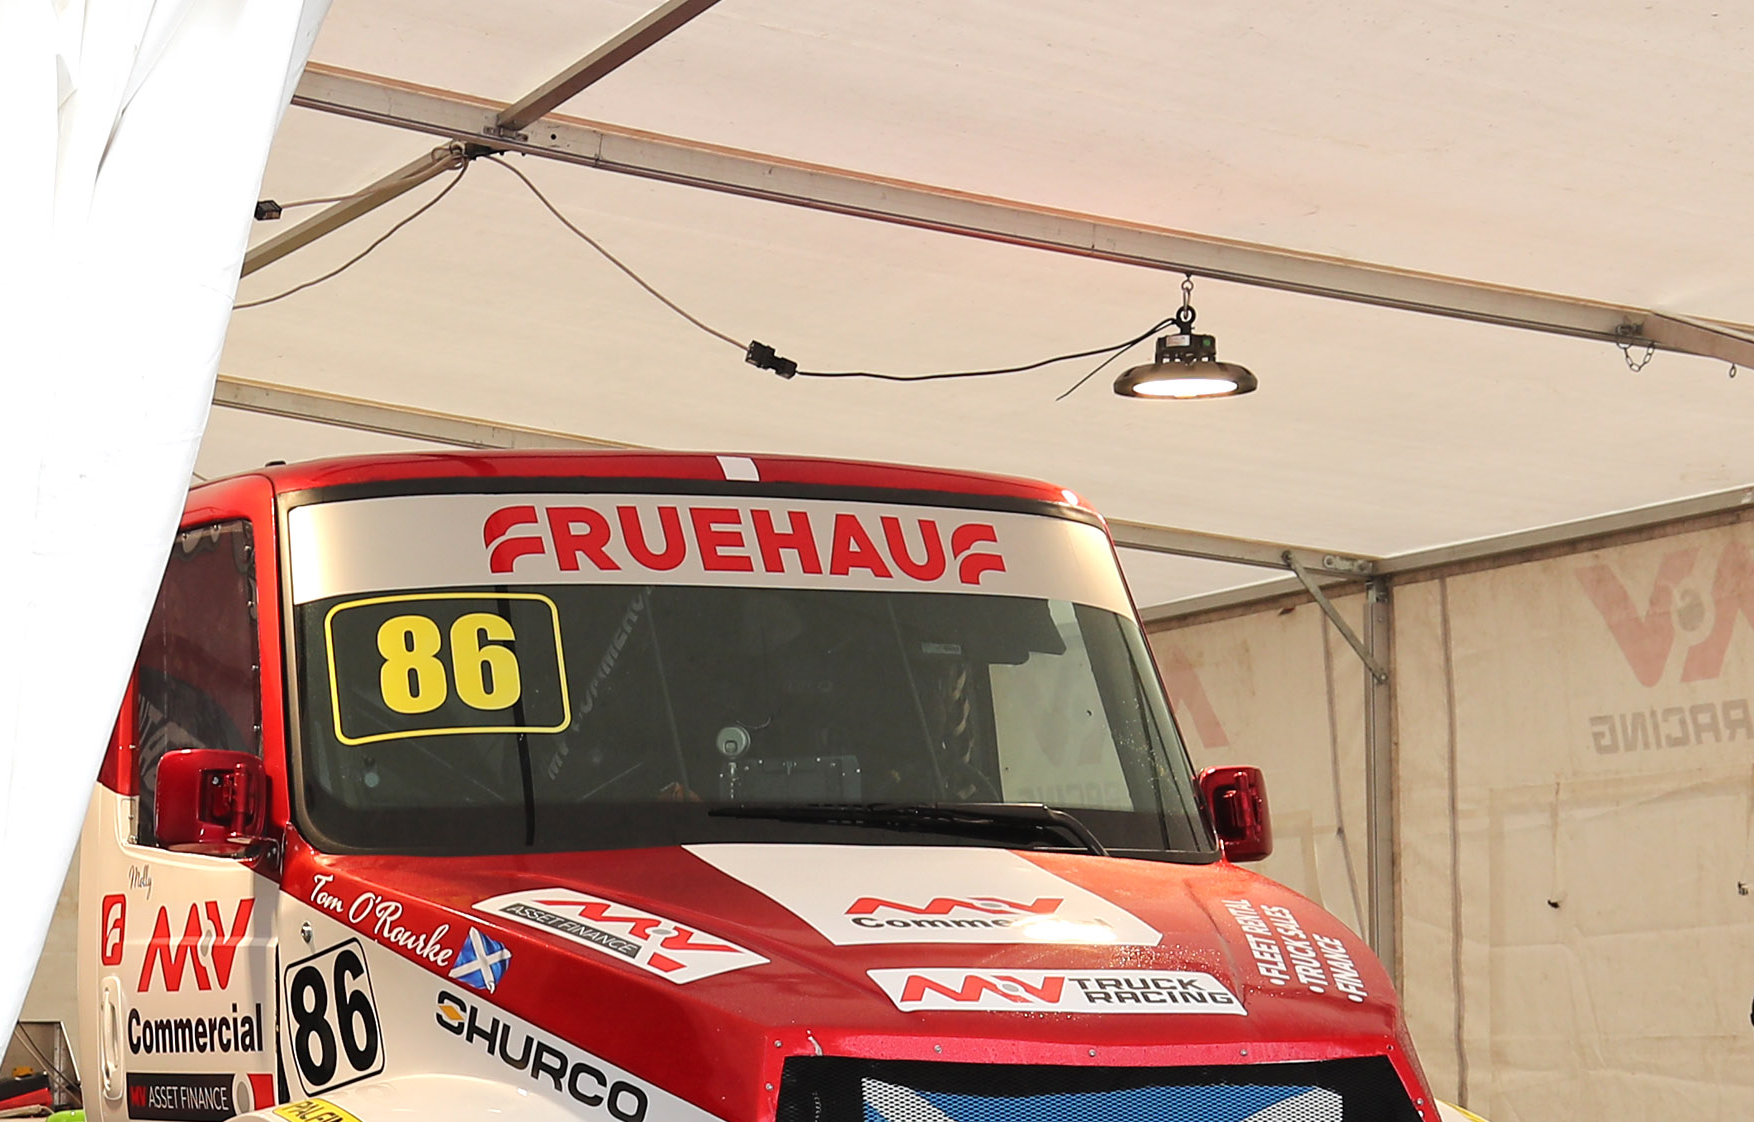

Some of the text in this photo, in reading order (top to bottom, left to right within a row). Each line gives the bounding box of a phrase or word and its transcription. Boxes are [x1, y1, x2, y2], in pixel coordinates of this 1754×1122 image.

[483, 505, 1007, 585] FRUEHAUF
[376, 612, 522, 714] 86
[138, 898, 255, 992] MV
[310, 874, 453, 968] Tom O'Rourke
[507, 905, 641, 954] ASSET FINANCE
[1221, 898, 1291, 980] FLEET RENTAL
[1260, 904, 1329, 986] TRUCK SALES
[1068, 977, 1206, 991] TRUCK
[1084, 991, 1235, 1004] RACING
[1312, 933, 1368, 997] FINANCE
[128, 1003, 264, 1055] Commercial
[291, 949, 379, 1086] 86
[148, 1086, 179, 1110] ASSET
[180, 1086, 230, 1111] FINANCE
